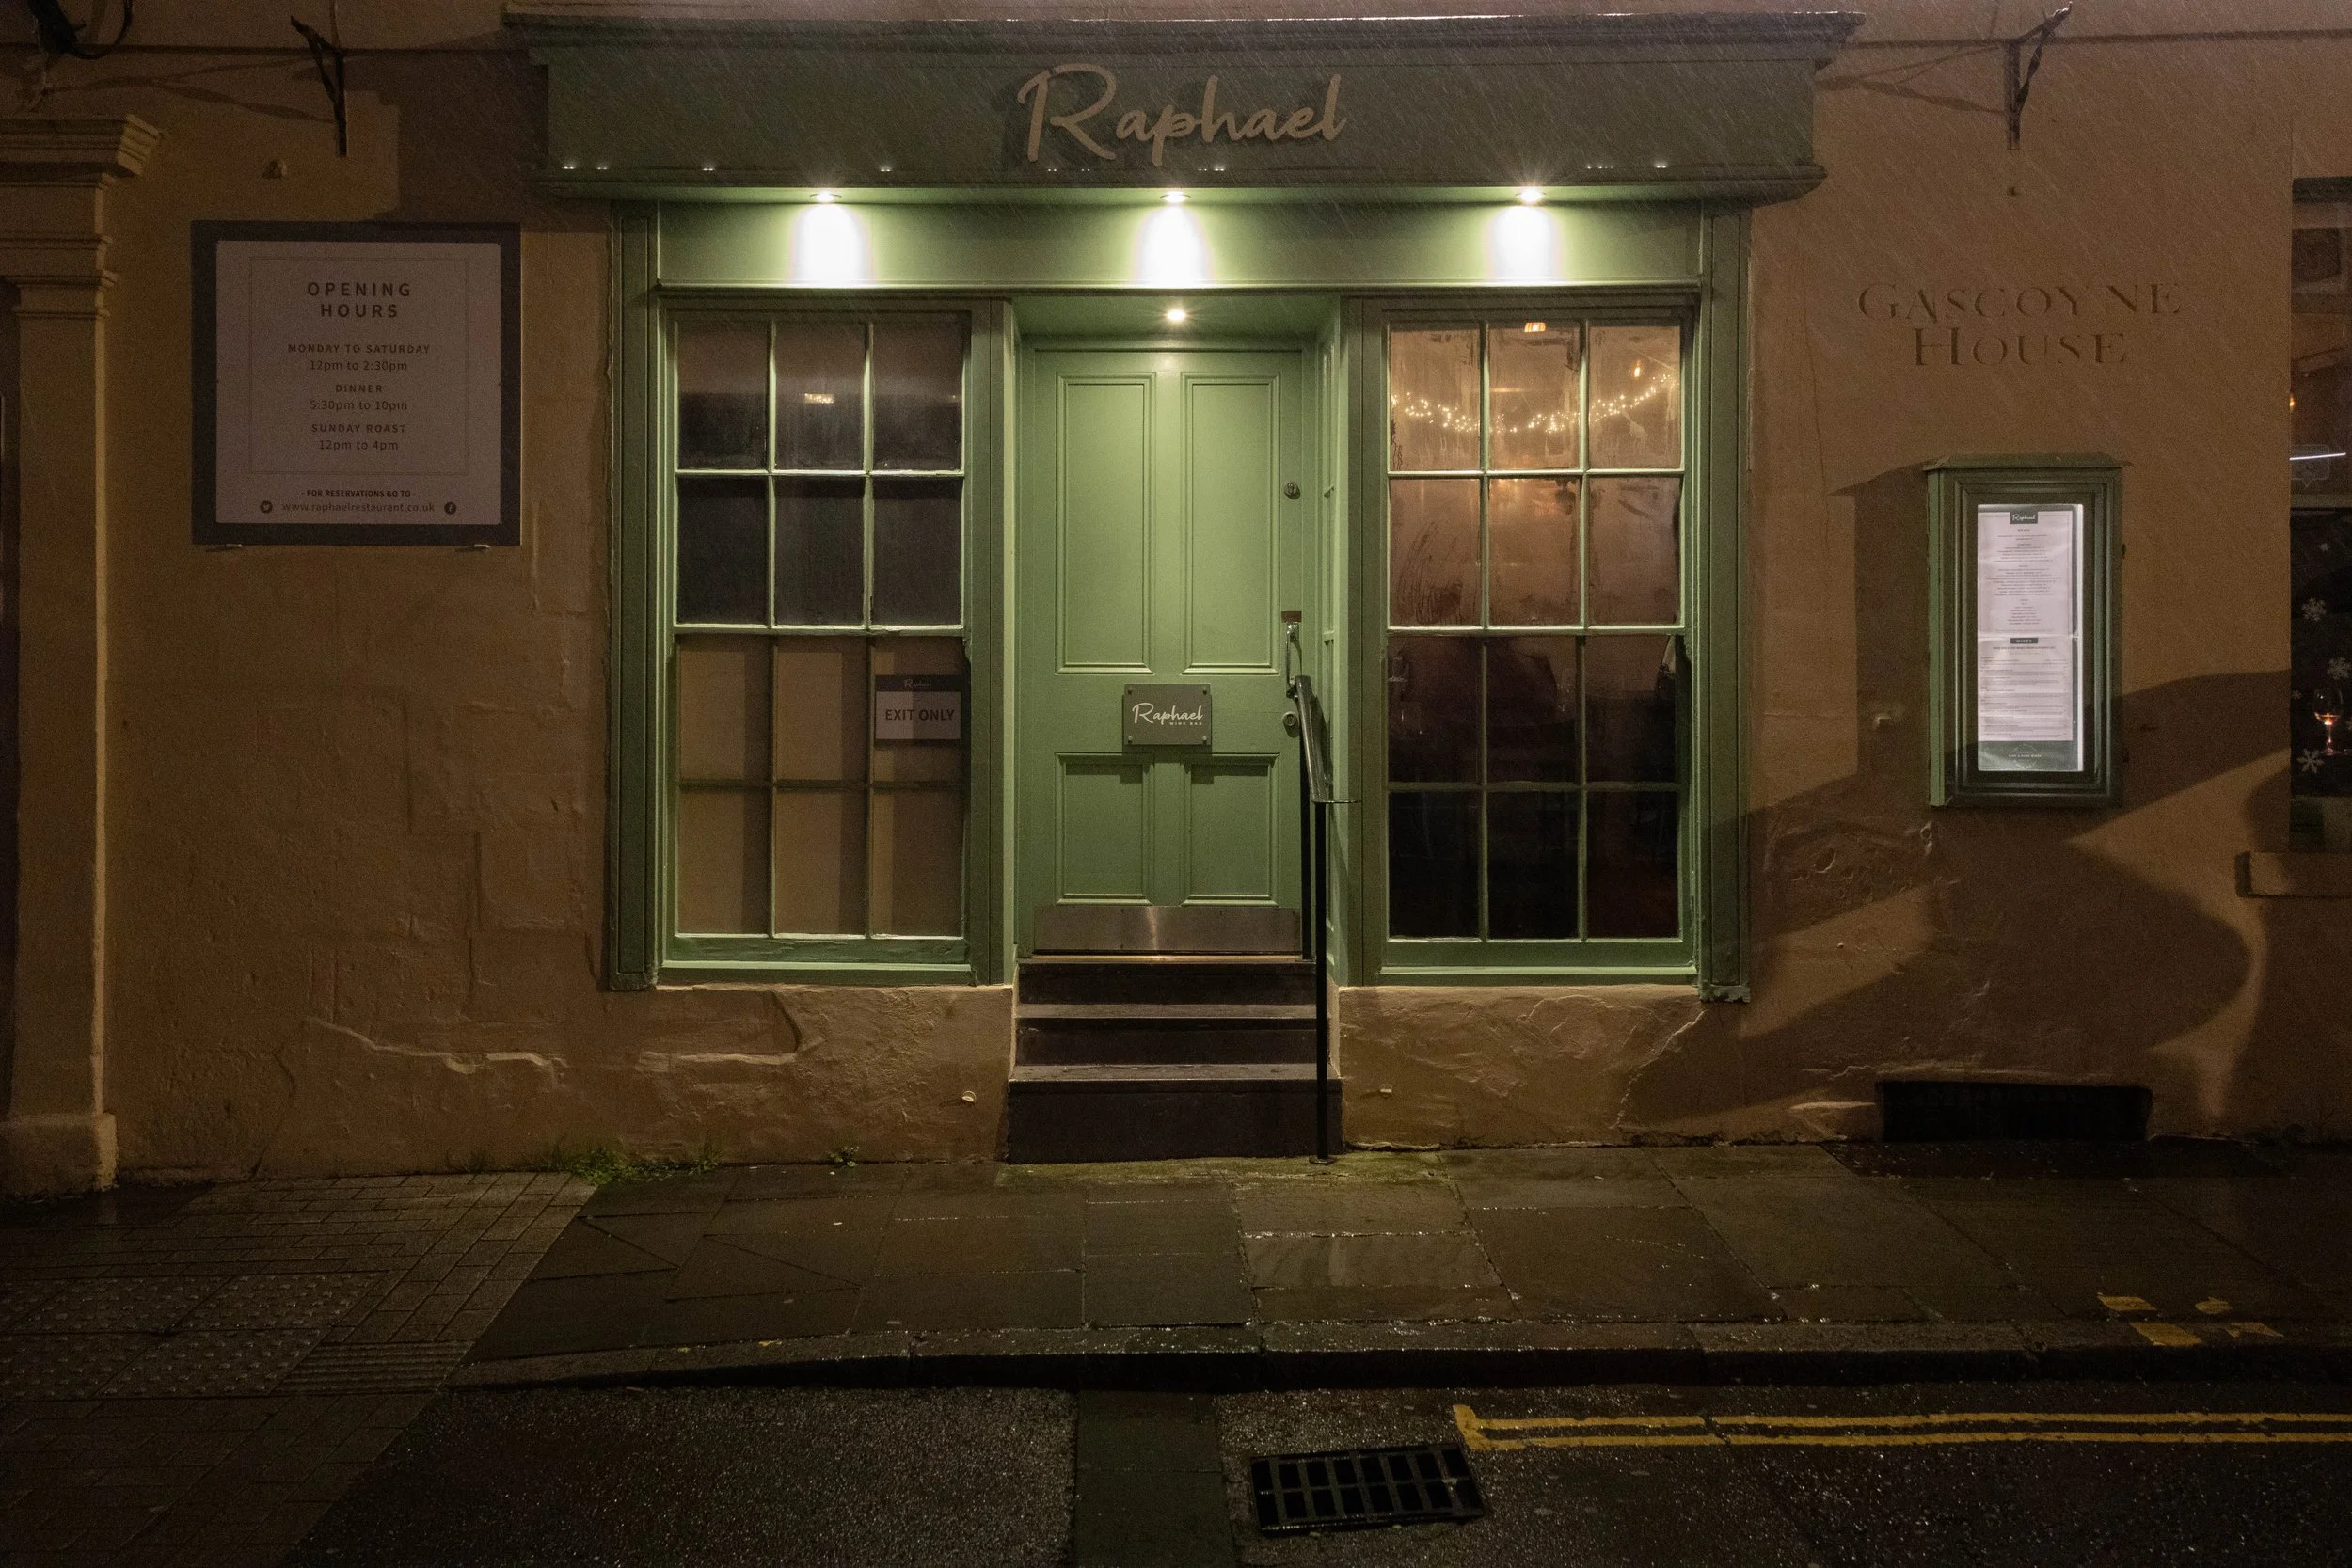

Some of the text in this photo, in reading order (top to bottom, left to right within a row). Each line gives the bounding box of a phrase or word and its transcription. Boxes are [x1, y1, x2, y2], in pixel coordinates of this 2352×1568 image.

[1017, 62, 1347, 167] Raphael
[307, 281, 412, 298] OPENING
[1858, 282, 2182, 324] GASCOYNE
[320, 303, 399, 319] HOURS
[287, 343, 431, 354] MONDAY TO SATURDAY
[1913, 327, 2125, 366] HOUSE
[310, 359, 407, 372] 12pm to 2:30pm
[335, 384, 383, 393] DINNER
[310, 400, 407, 411] 5:30pm to 10pm
[311, 423, 406, 434] SUNDAY ROAST
[319, 439, 399, 451] 12pm to 4pm
[307, 489, 323, 498] FOR
[325, 489, 385, 498] RESERVATIONS
[282, 502, 436, 513] www.raphaelrestaurant.co.uk
[885, 708, 955, 721] EXIT ONLY
[1132, 702, 1203, 726] Raphael
